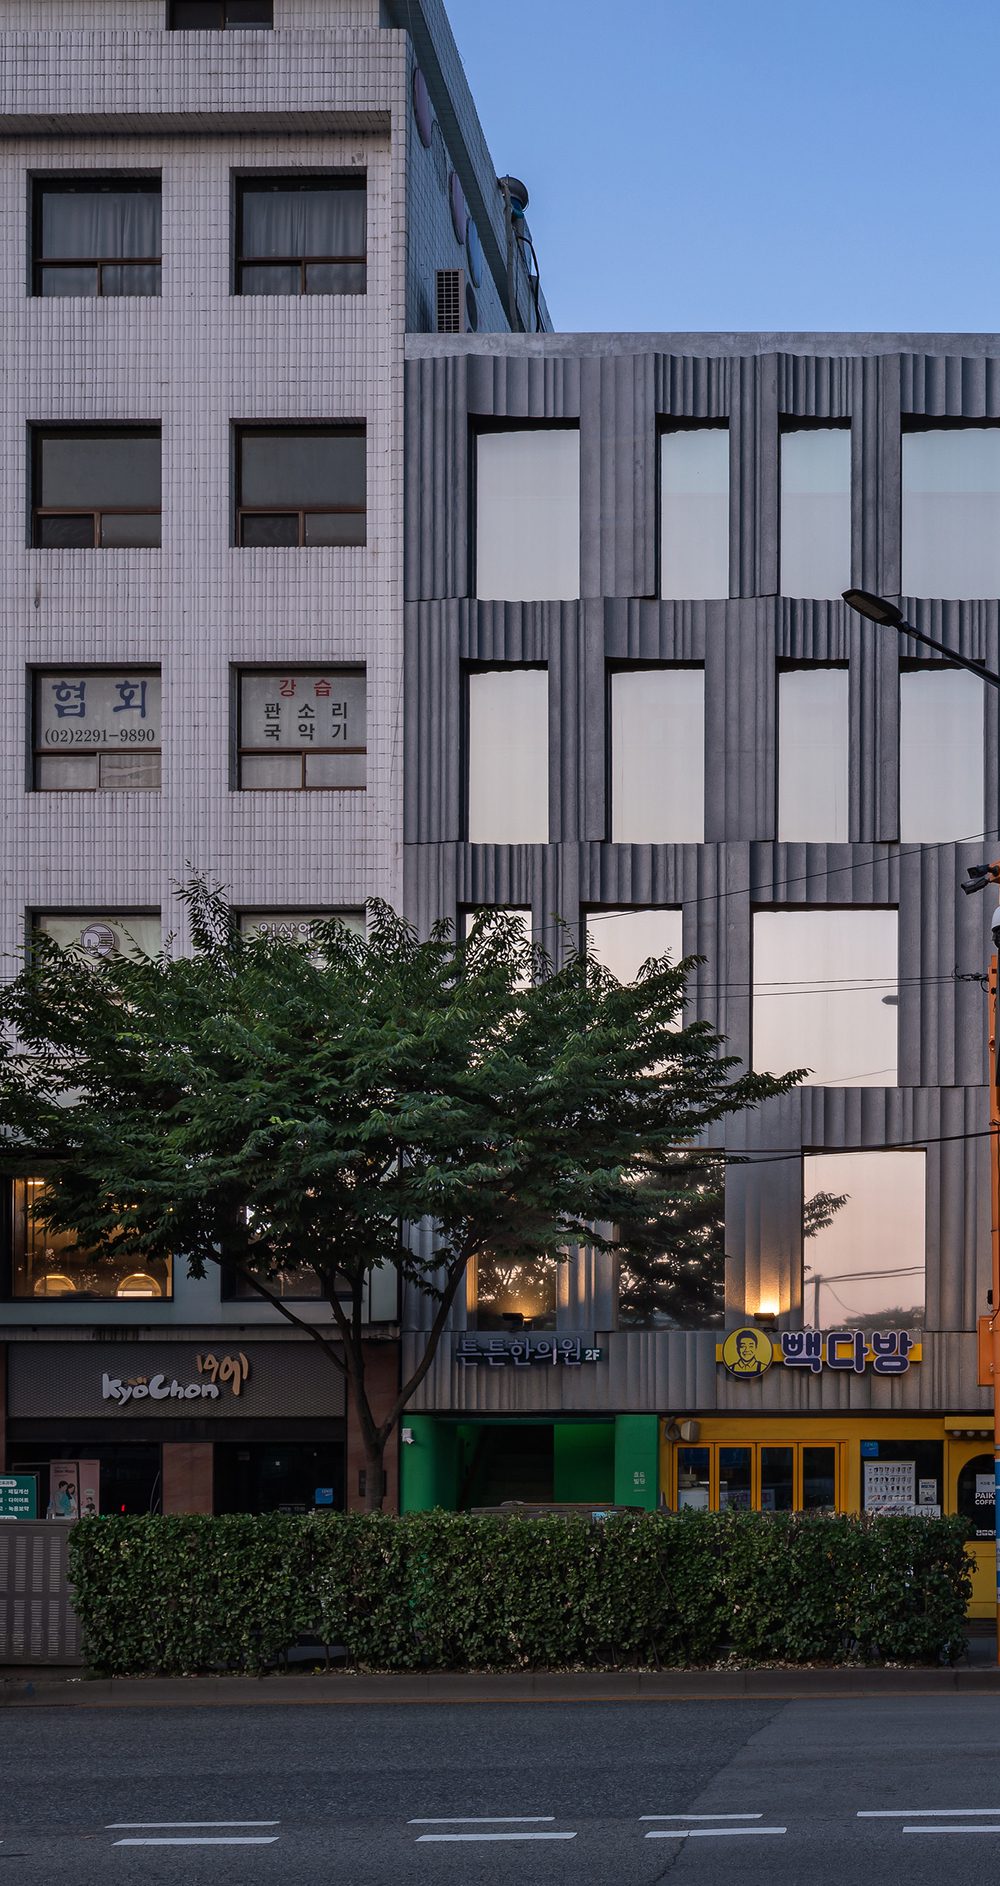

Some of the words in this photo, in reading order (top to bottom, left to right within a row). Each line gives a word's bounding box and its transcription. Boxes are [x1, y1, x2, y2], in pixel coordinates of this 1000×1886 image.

[51, 680, 149, 719] 협회
[264, 701, 348, 720] 판소리
[44, 728, 156, 745] (02)2291-9890
[264, 722, 348, 741] 국악기
[456, 1337, 582, 1366] 튼튼한의원
[584, 1349, 601, 1361] 2F
[781, 1331, 914, 1374] 빽다방
